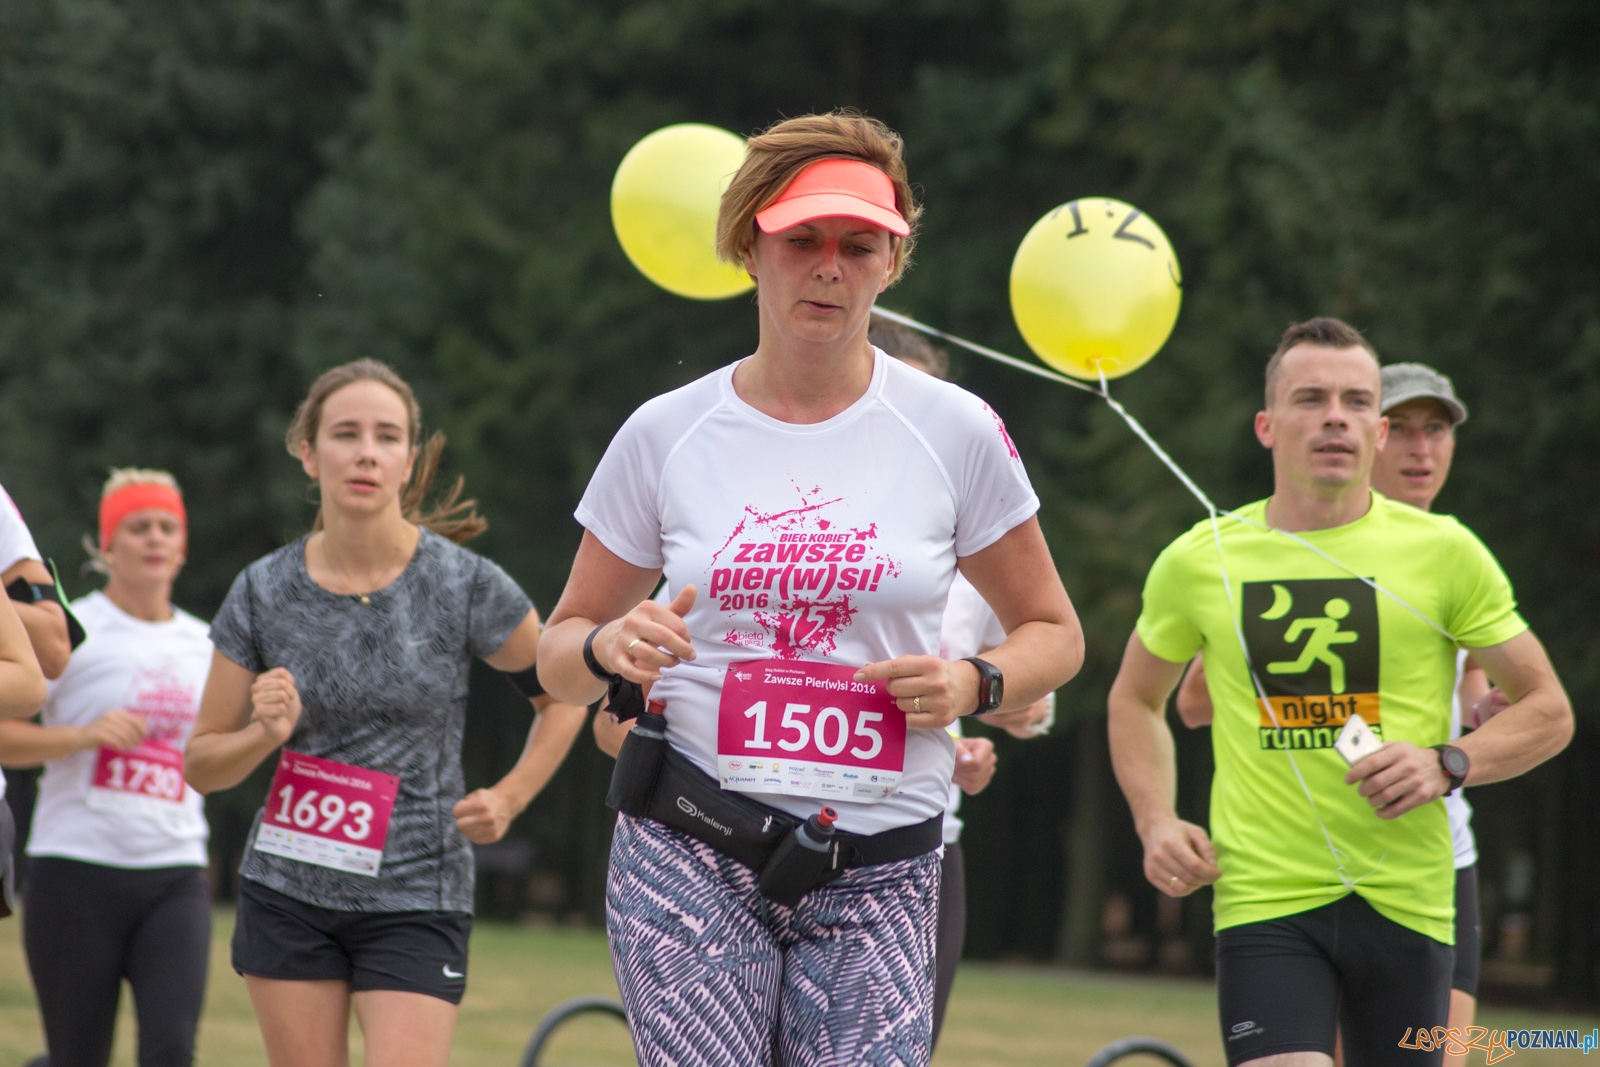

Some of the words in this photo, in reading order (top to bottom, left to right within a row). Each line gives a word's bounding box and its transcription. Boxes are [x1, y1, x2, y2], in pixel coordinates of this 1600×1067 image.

[733, 543, 866, 563] zawsze
[779, 533, 807, 543] BIEG
[808, 533, 852, 543] KOBIET
[709, 563, 885, 600] pier(w)si!
[719, 593, 768, 611] 2016
[788, 605, 834, 647] 15
[763, 673, 803, 686] Zawsze
[805, 676, 848, 692] Pier(w)si
[850, 682, 876, 695] 2016
[1281, 696, 1358, 726] night
[743, 700, 883, 760] 1505
[106, 756, 182, 799] 1730
[274, 784, 374, 840] 1693
[697, 810, 733, 836] Kalenji
